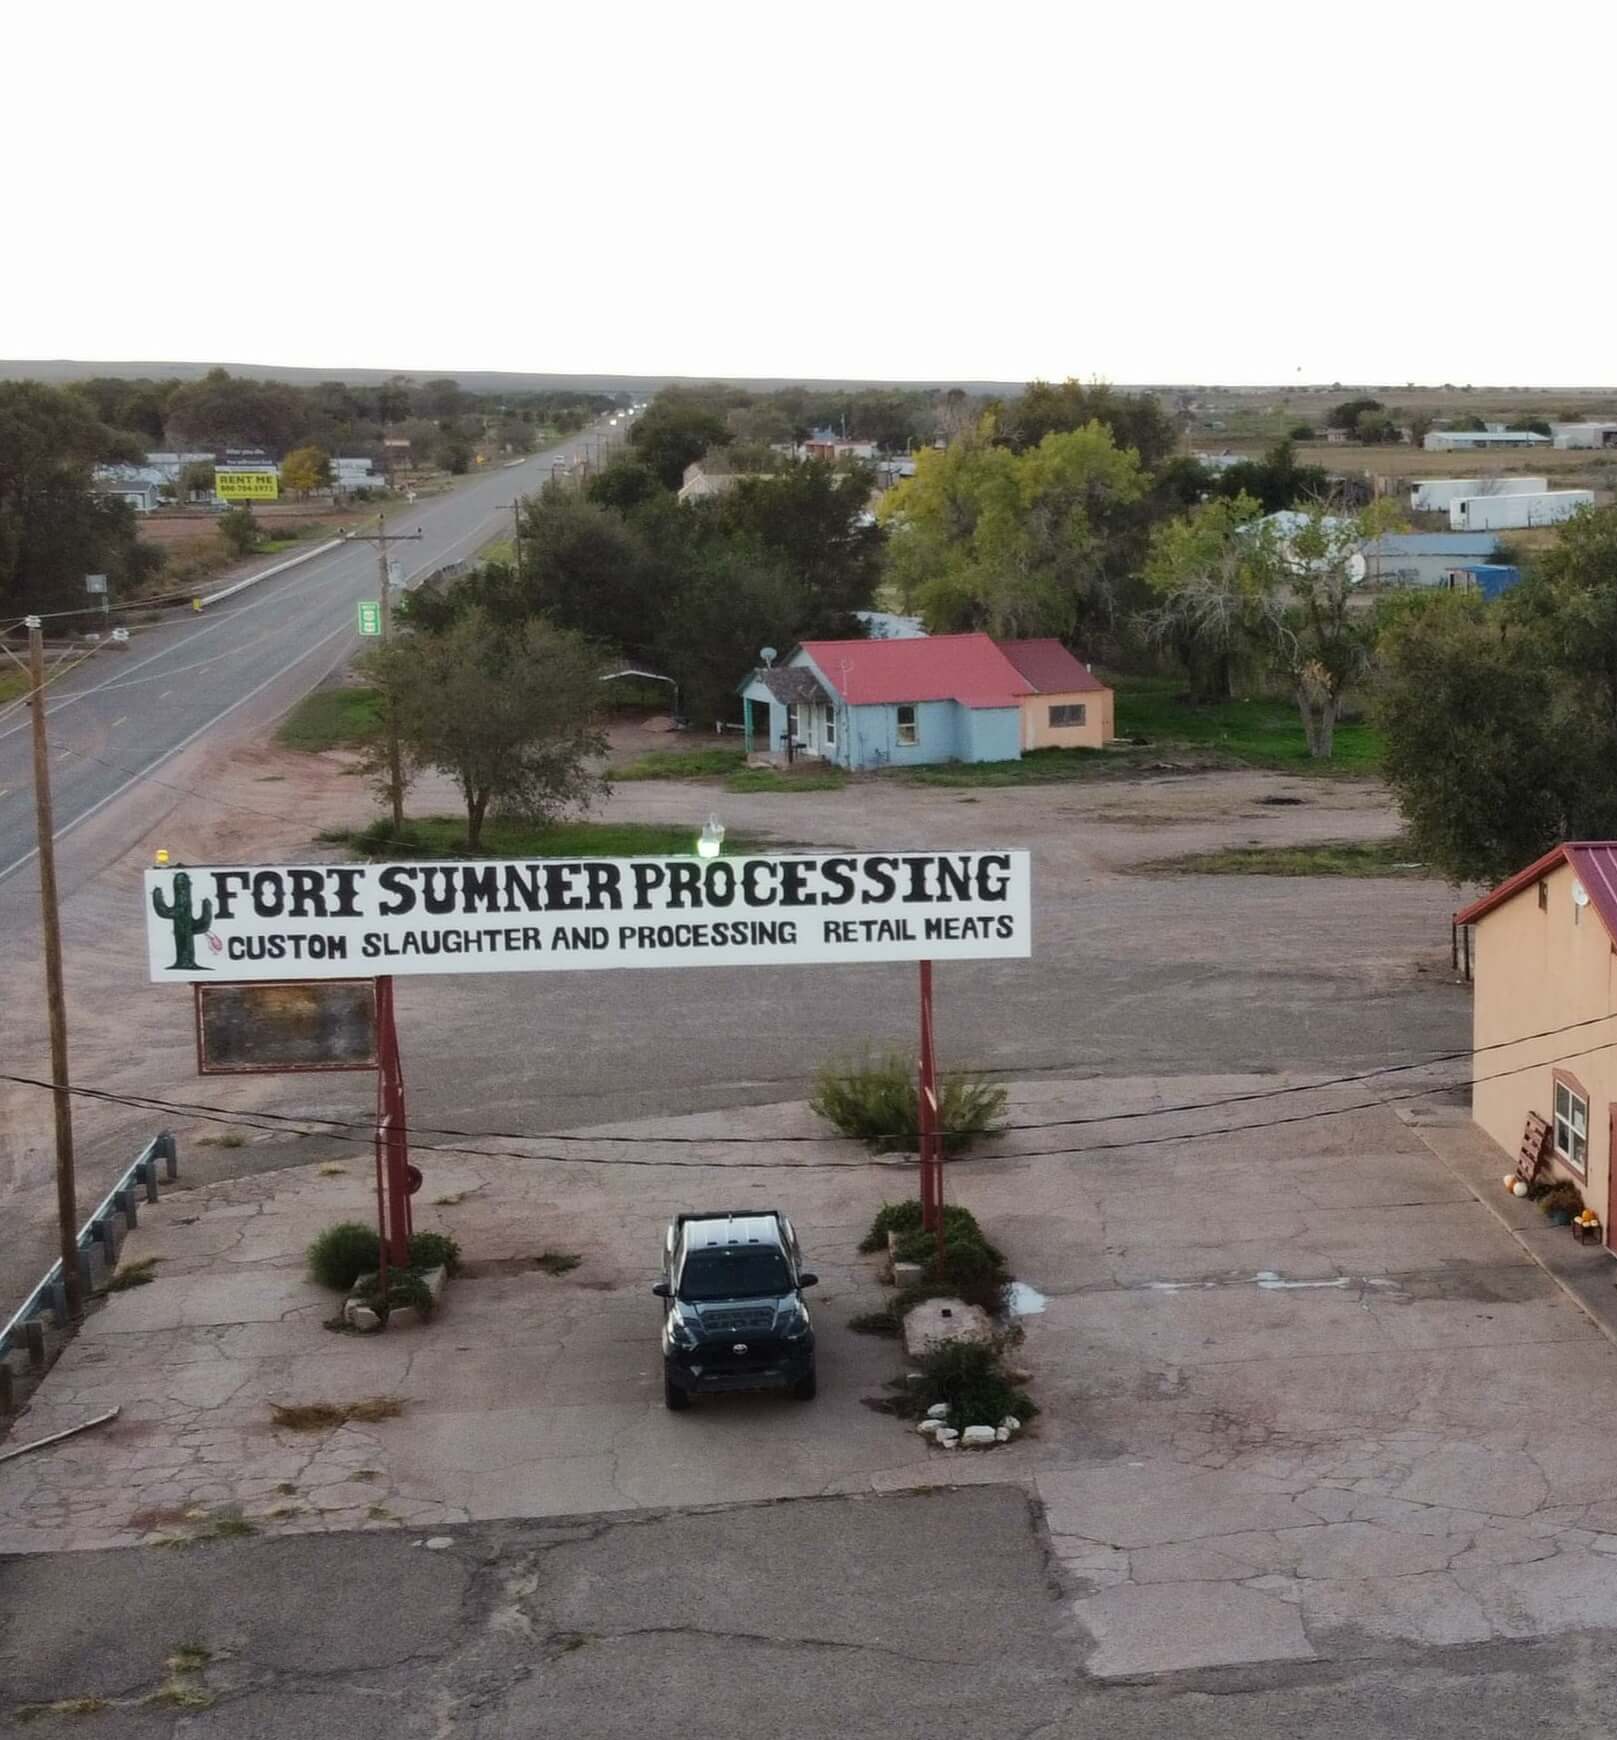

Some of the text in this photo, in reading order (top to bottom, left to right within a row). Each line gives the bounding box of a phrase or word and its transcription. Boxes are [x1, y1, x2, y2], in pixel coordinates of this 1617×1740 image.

[219, 475, 273, 484] RENT ME
[211, 853, 1010, 919] FORT SUMNER PROCESSING
[229, 916, 1013, 960] CUSTOM SLAUGHTER AND PROCESSING RETAIL MEATS
